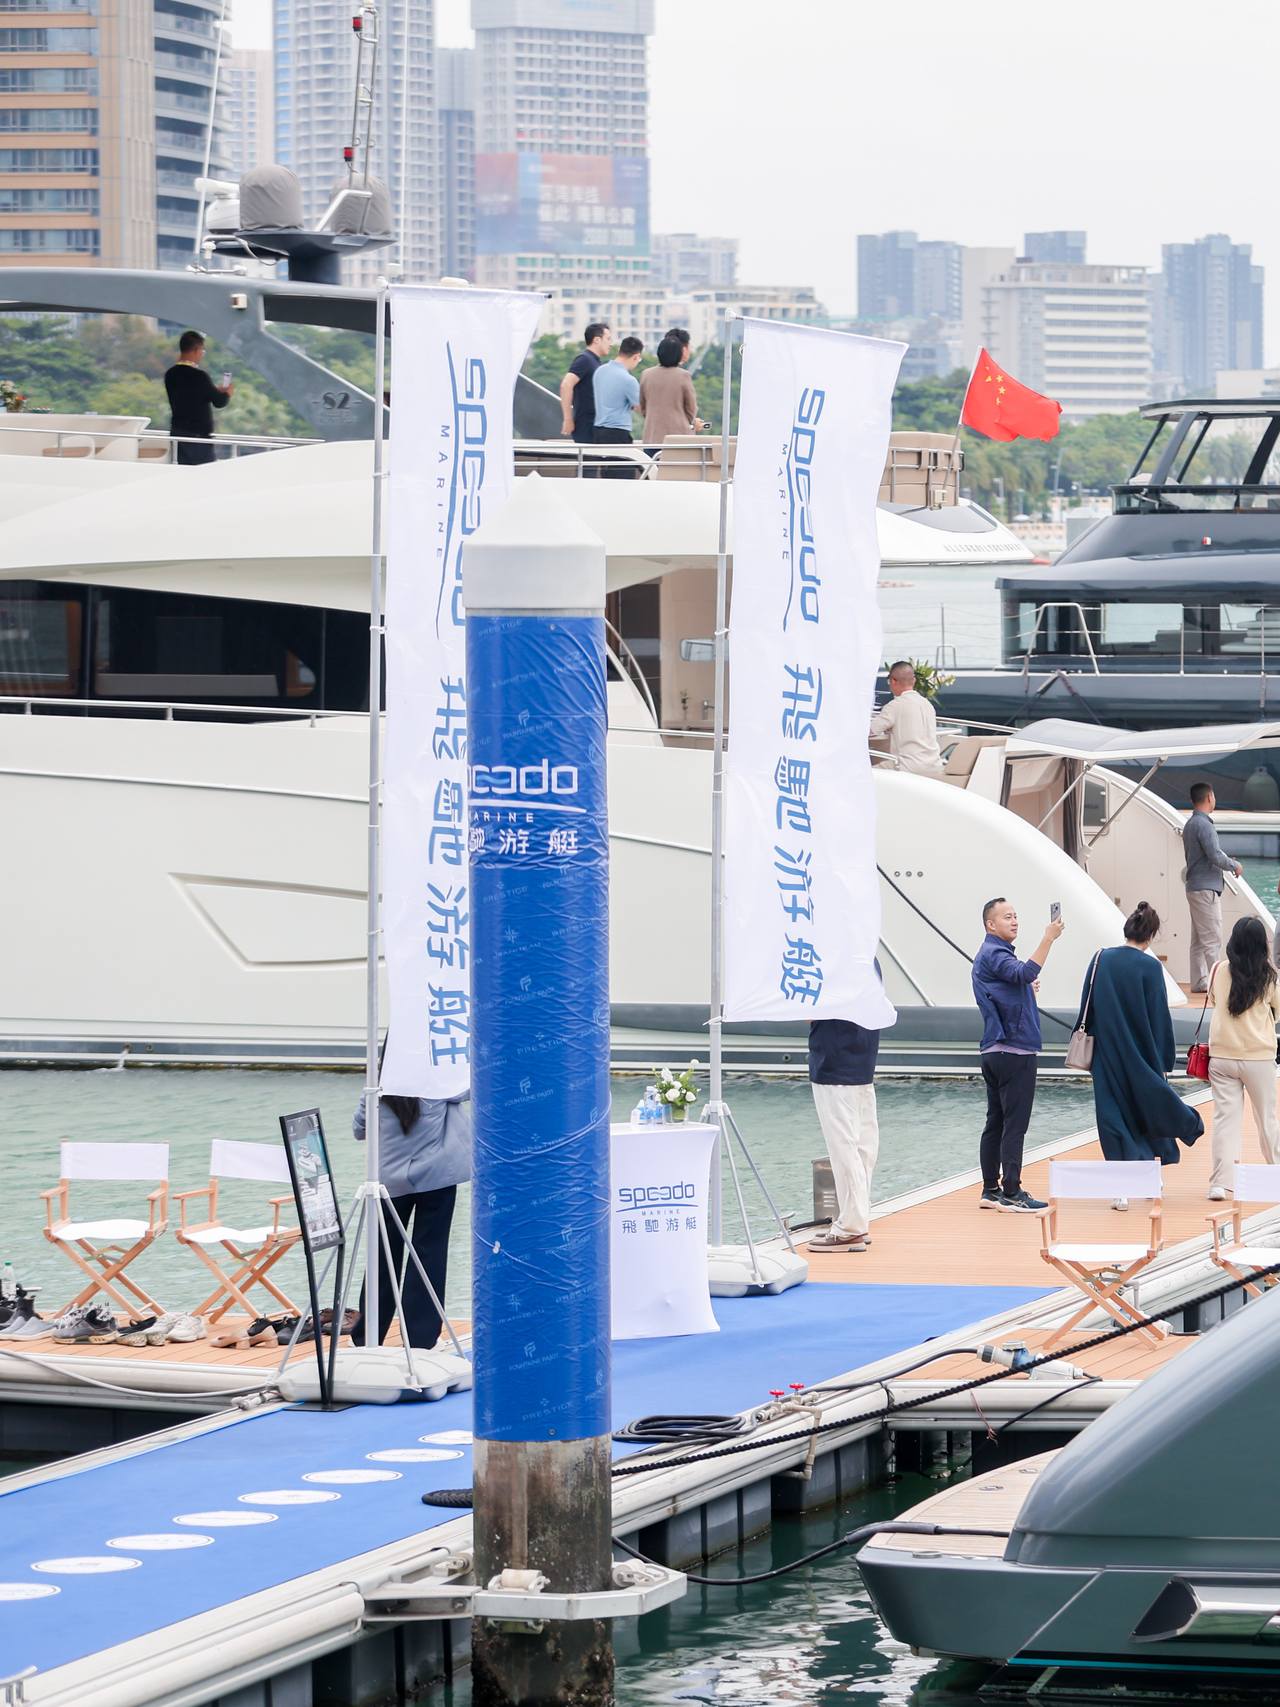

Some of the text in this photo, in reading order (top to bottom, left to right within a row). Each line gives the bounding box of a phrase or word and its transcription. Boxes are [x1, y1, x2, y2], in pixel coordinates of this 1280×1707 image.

[436, 424, 450, 558] MARINE
[777, 443, 789, 561] MARINE
[774, 664, 824, 1006] 飛馳游艇
[622, 1217, 697, 1233] 飛馳游艇
